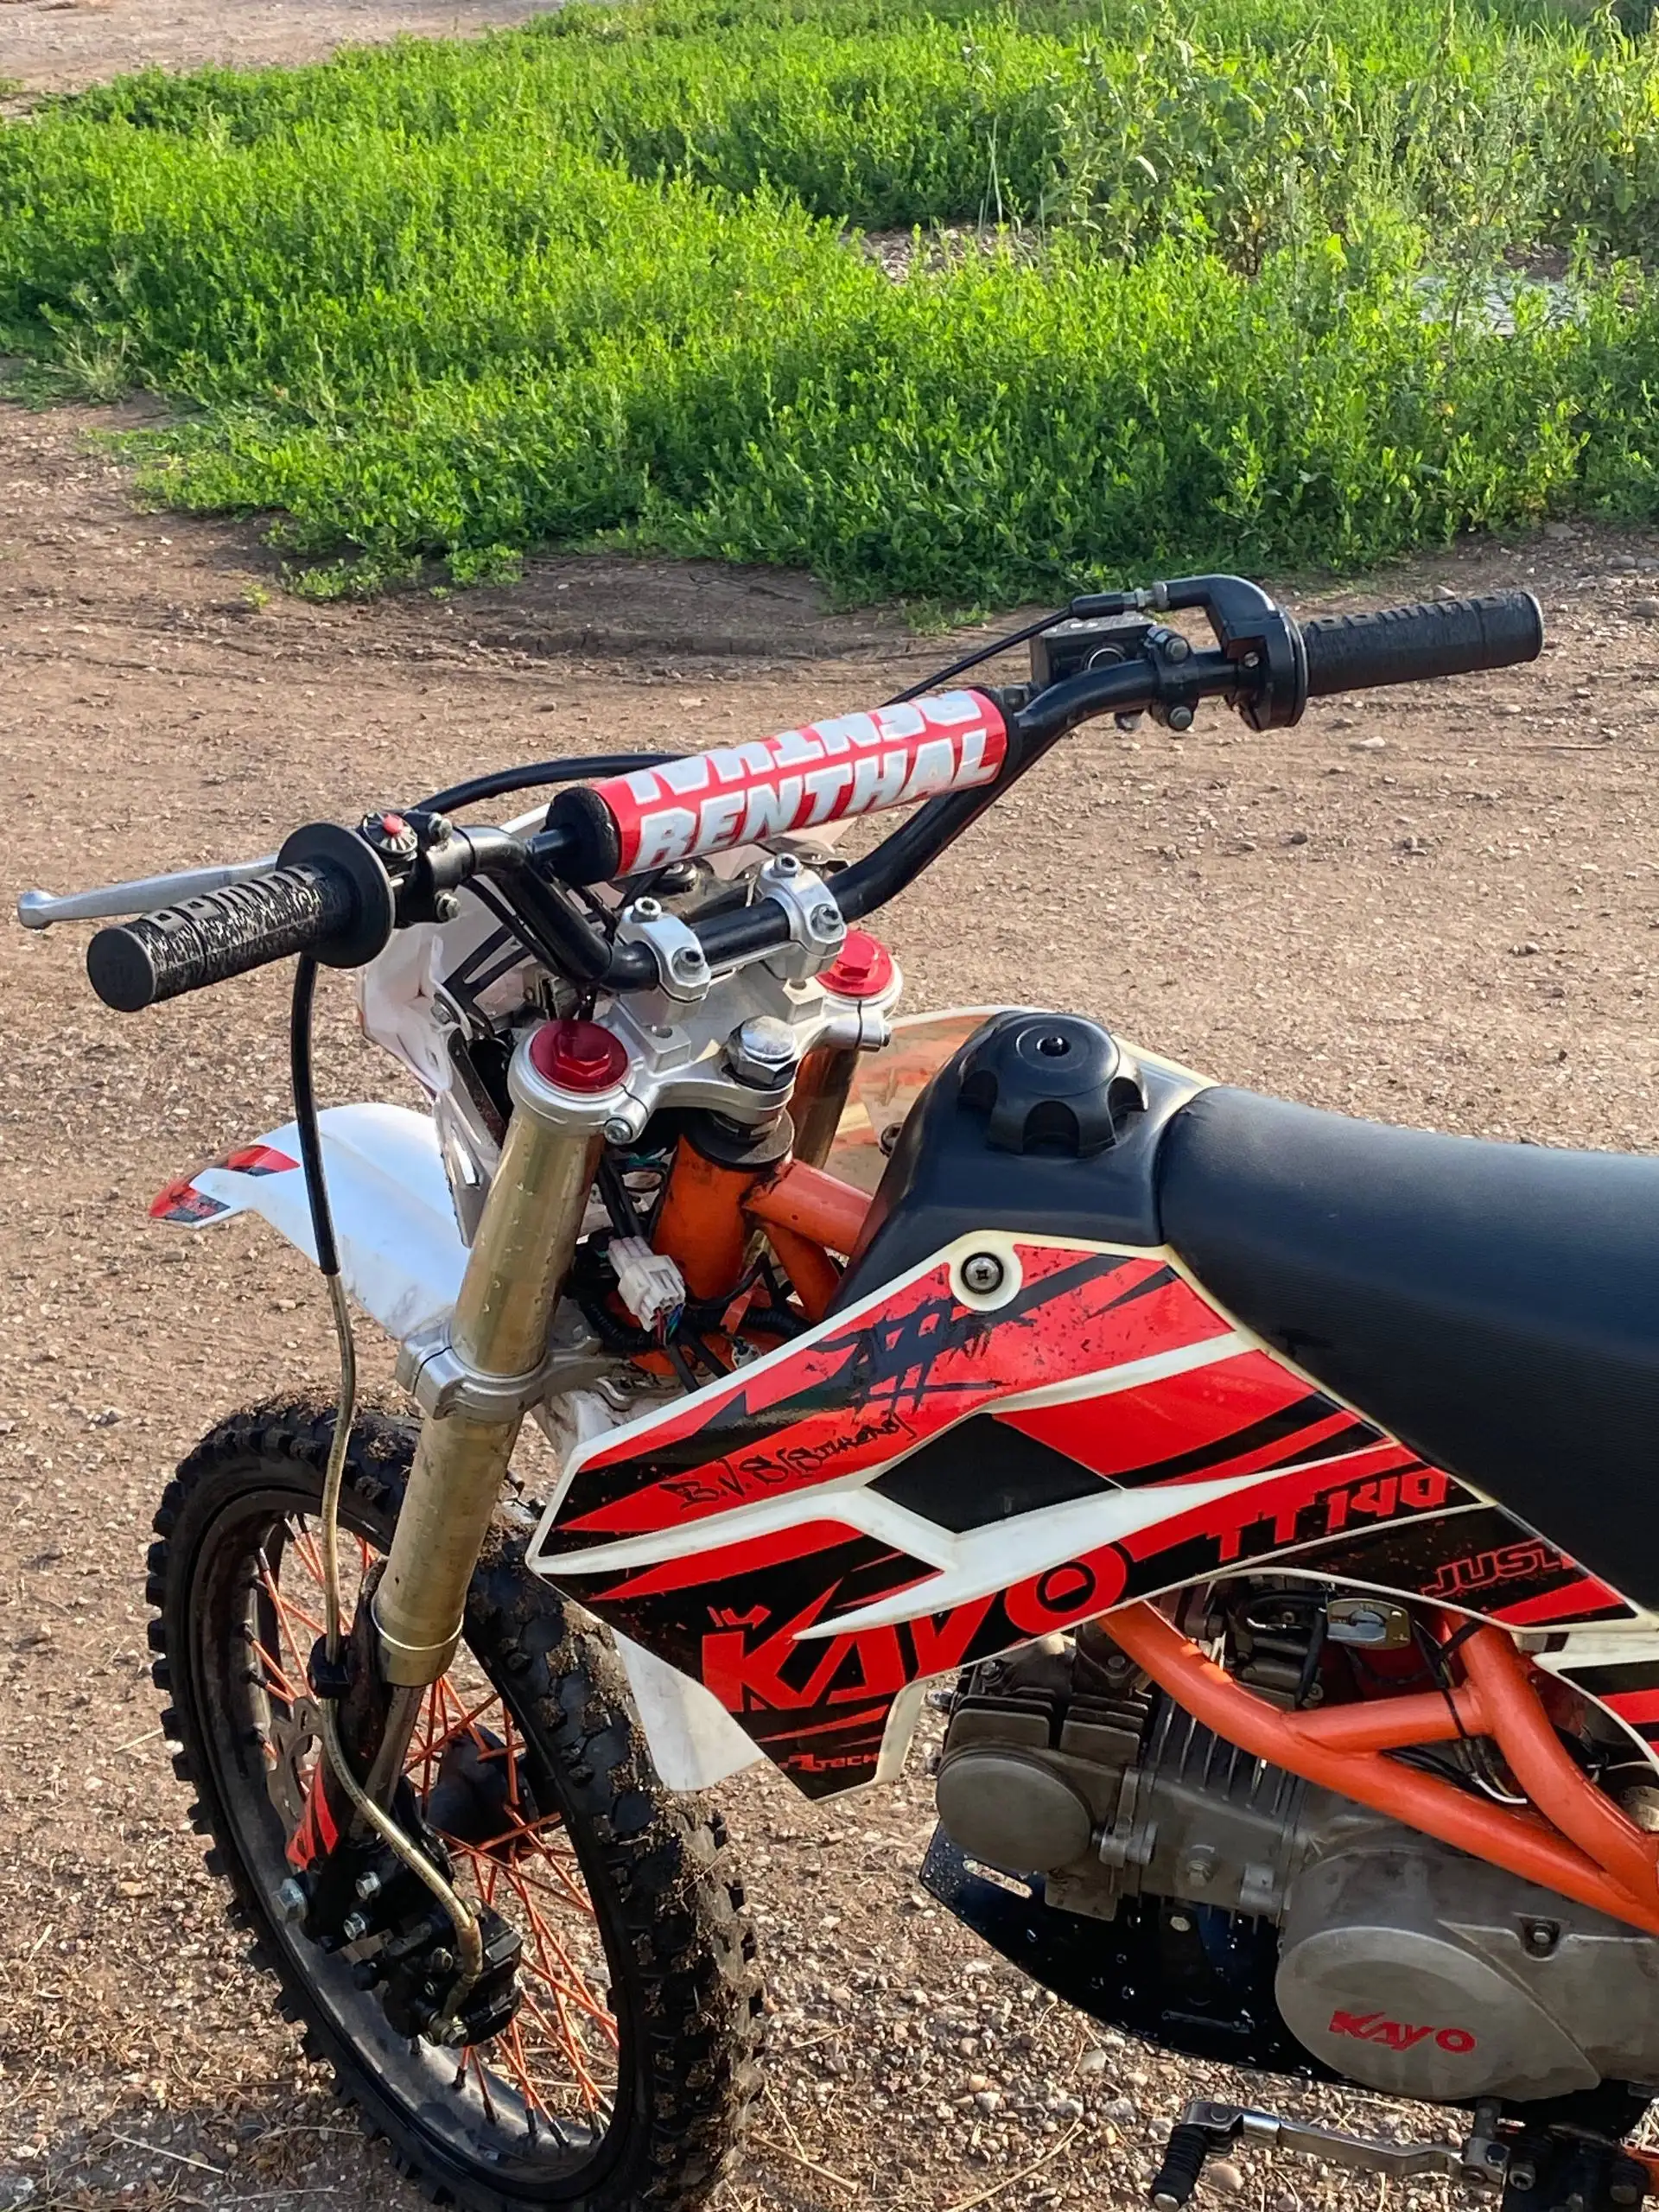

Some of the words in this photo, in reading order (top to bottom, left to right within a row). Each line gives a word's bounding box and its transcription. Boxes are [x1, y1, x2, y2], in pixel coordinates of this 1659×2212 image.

[634, 728, 1000, 867] RENTHAL
[1205, 1466, 1449, 1562] TT140
[701, 1541, 1128, 1713] KAYO
[1328, 2010, 1476, 2054] KAYO
